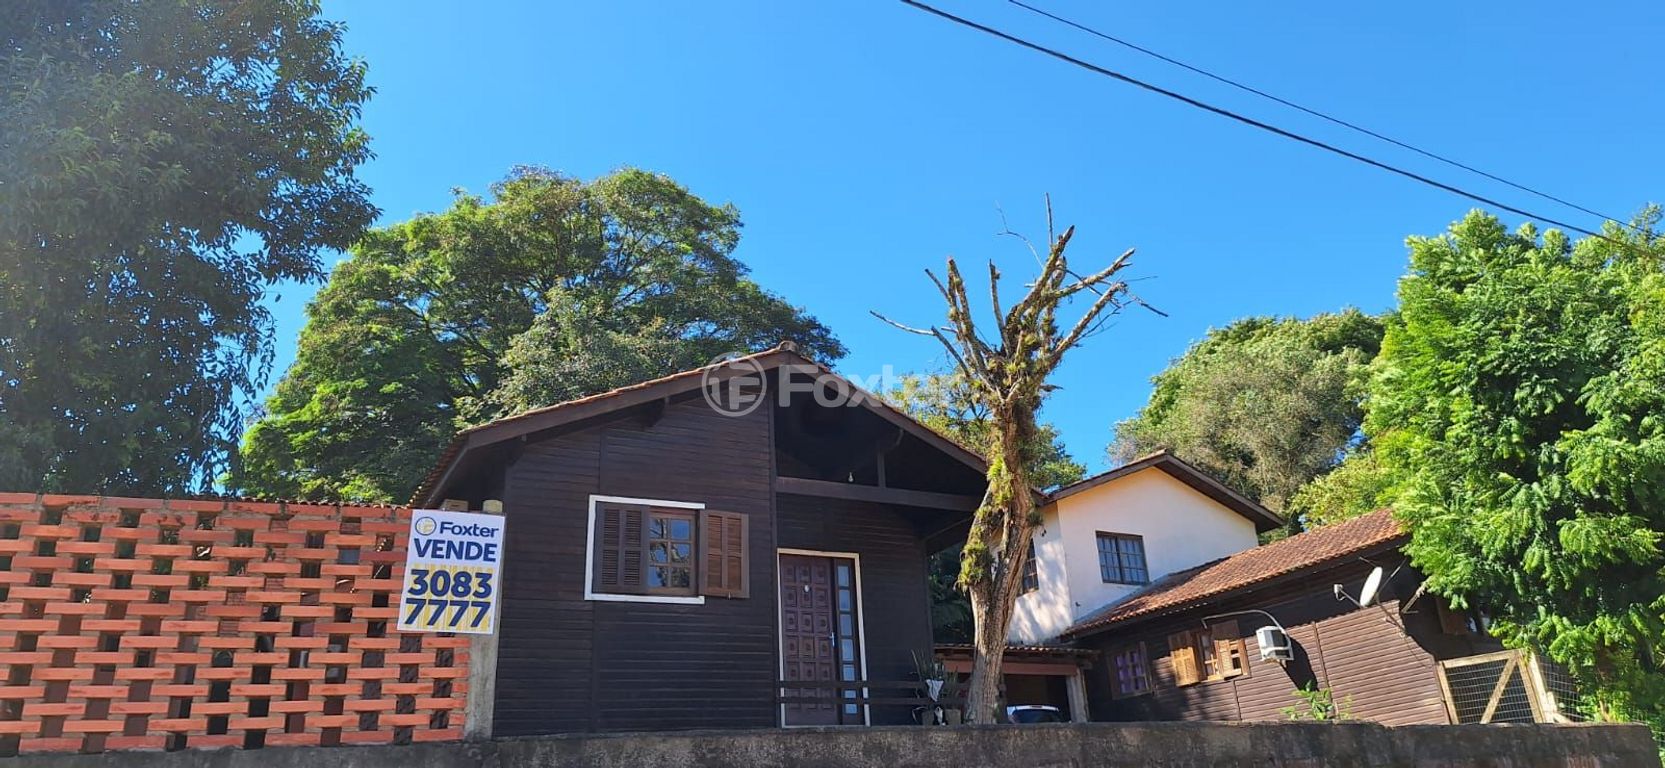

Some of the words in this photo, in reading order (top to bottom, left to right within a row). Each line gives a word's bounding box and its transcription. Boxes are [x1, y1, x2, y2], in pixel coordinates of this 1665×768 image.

[440, 521, 499, 538] Foxter
[414, 538, 497, 562] VENDE
[407, 569, 493, 599] 3083
[404, 597, 491, 628] 7777
